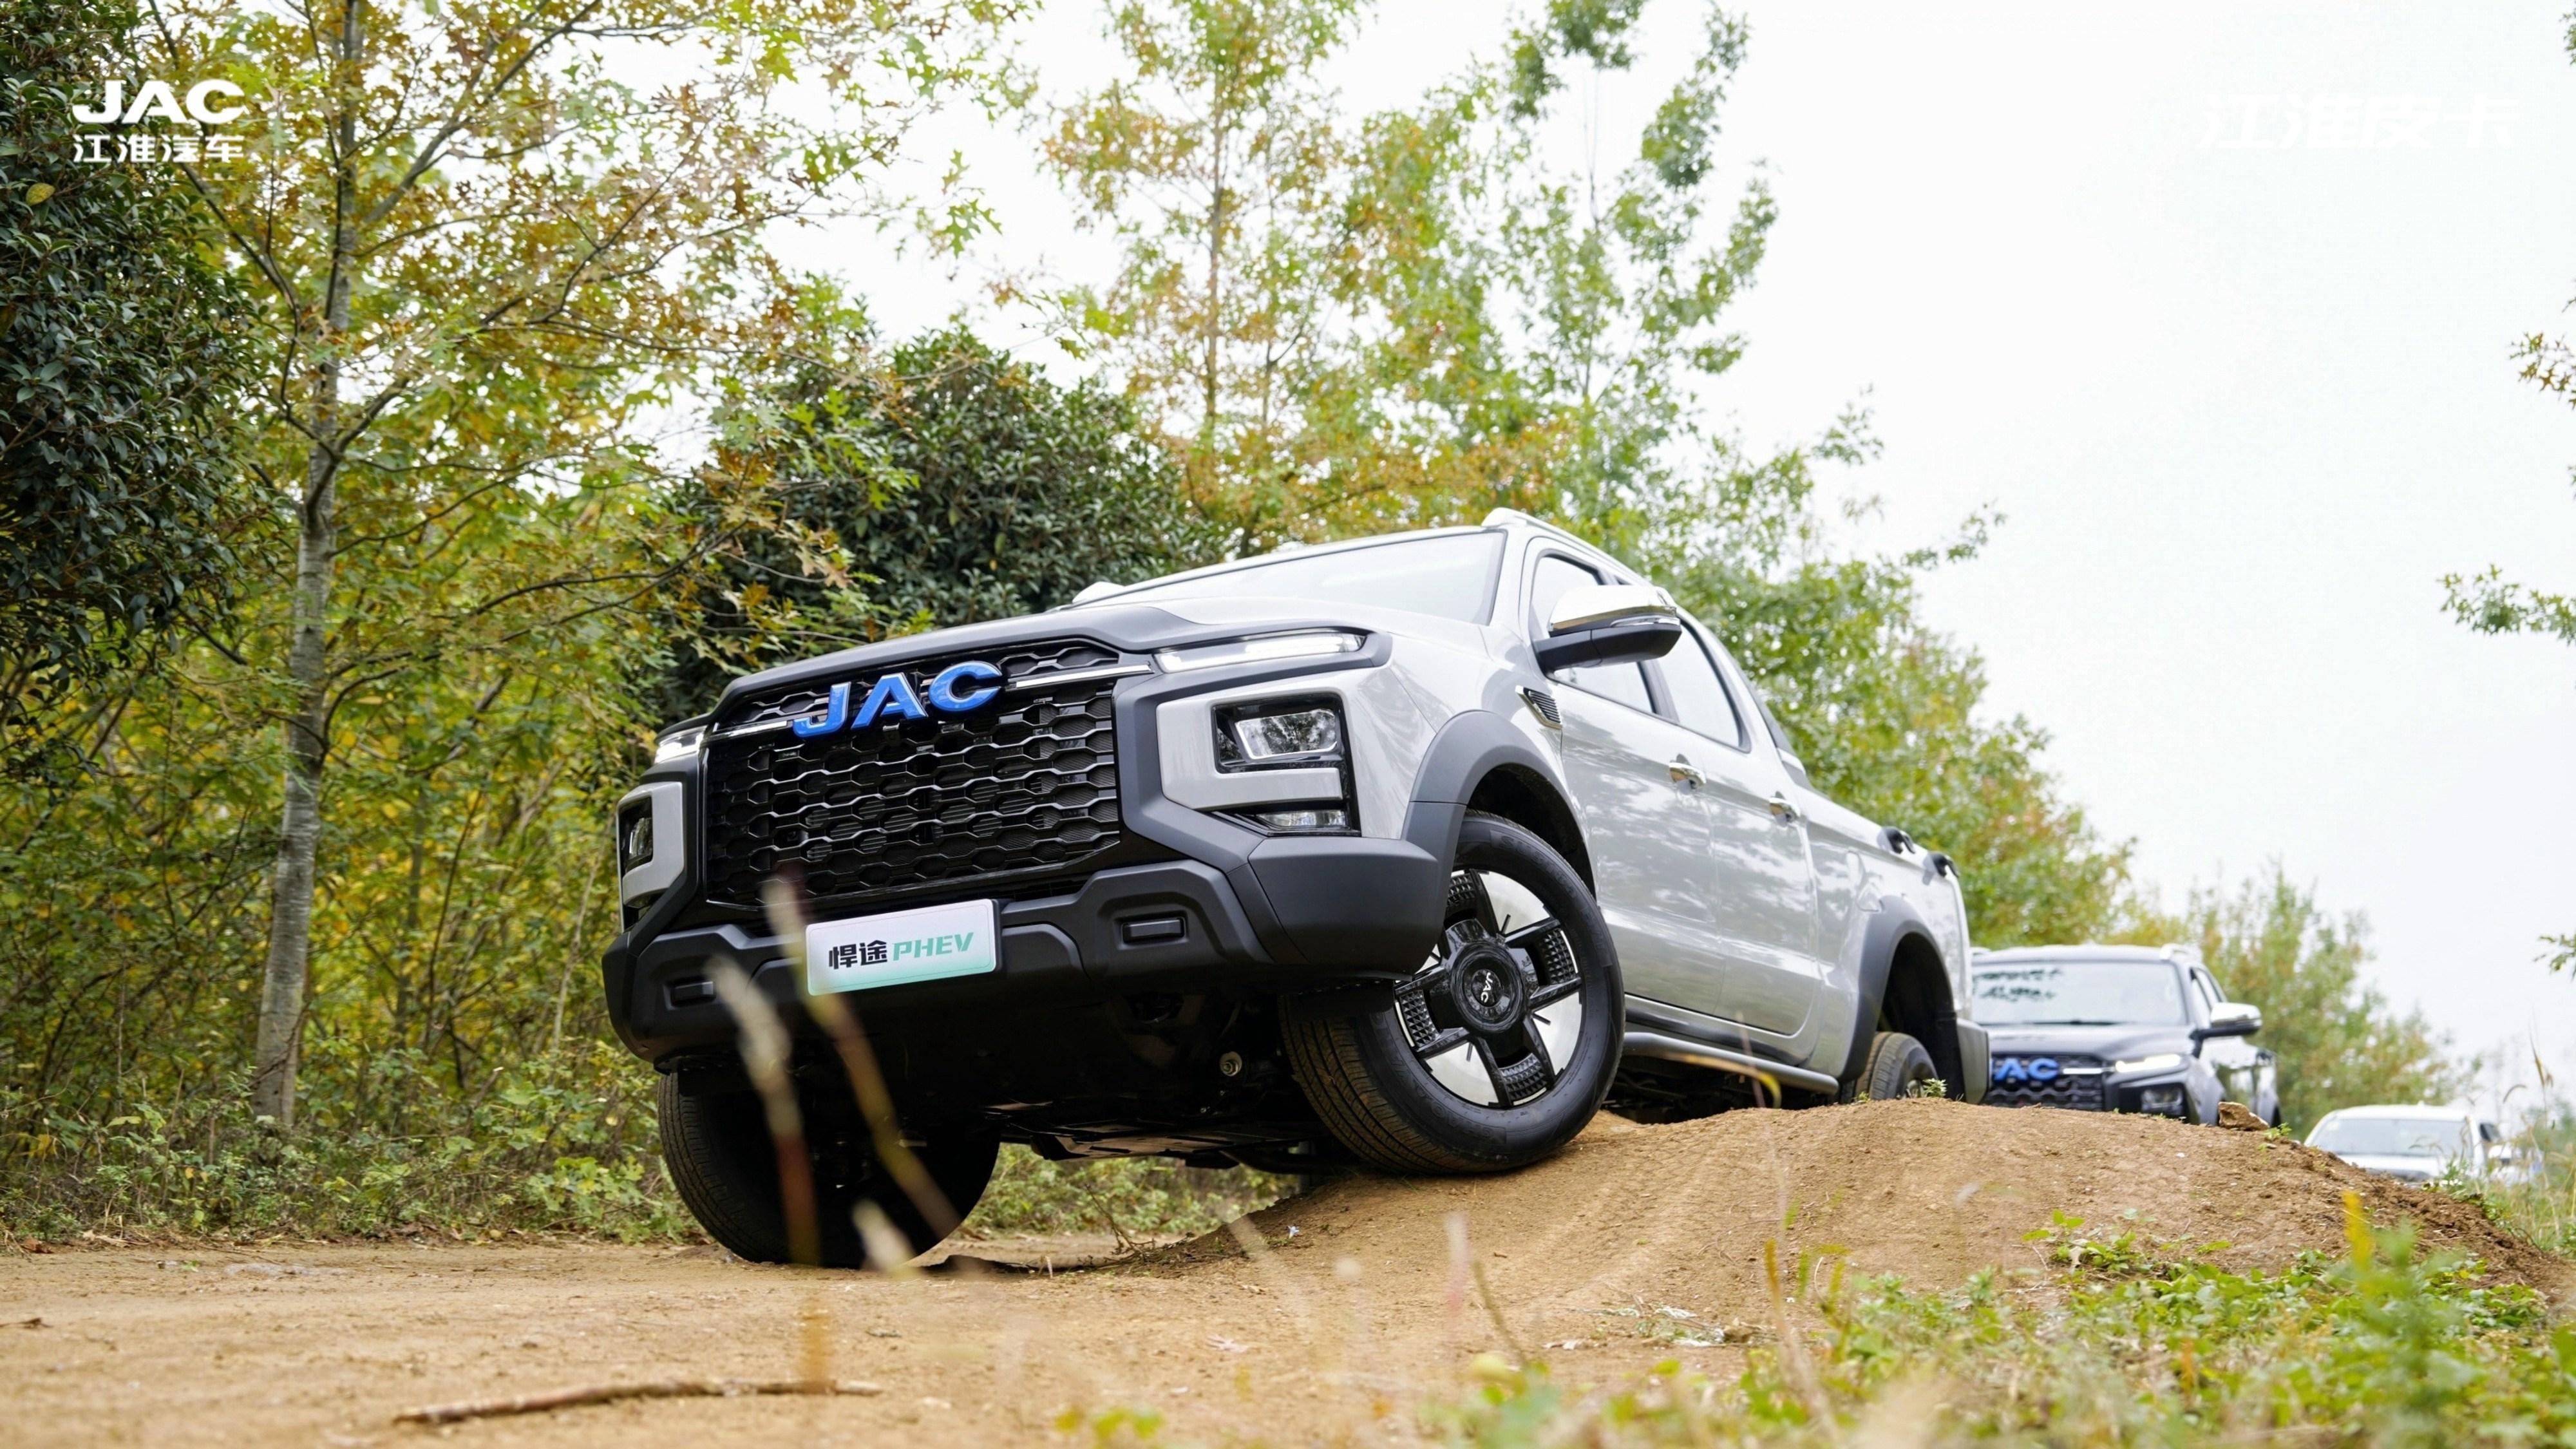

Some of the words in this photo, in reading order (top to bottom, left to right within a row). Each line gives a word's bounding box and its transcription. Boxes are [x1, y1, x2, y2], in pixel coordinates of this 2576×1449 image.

[793, 661, 1003, 738] JAC
[829, 940, 887, 970] 悍途
[893, 933, 974, 961] PHEV
[1481, 972, 1493, 1003] JAC
[1990, 1057, 2060, 1081] AC
